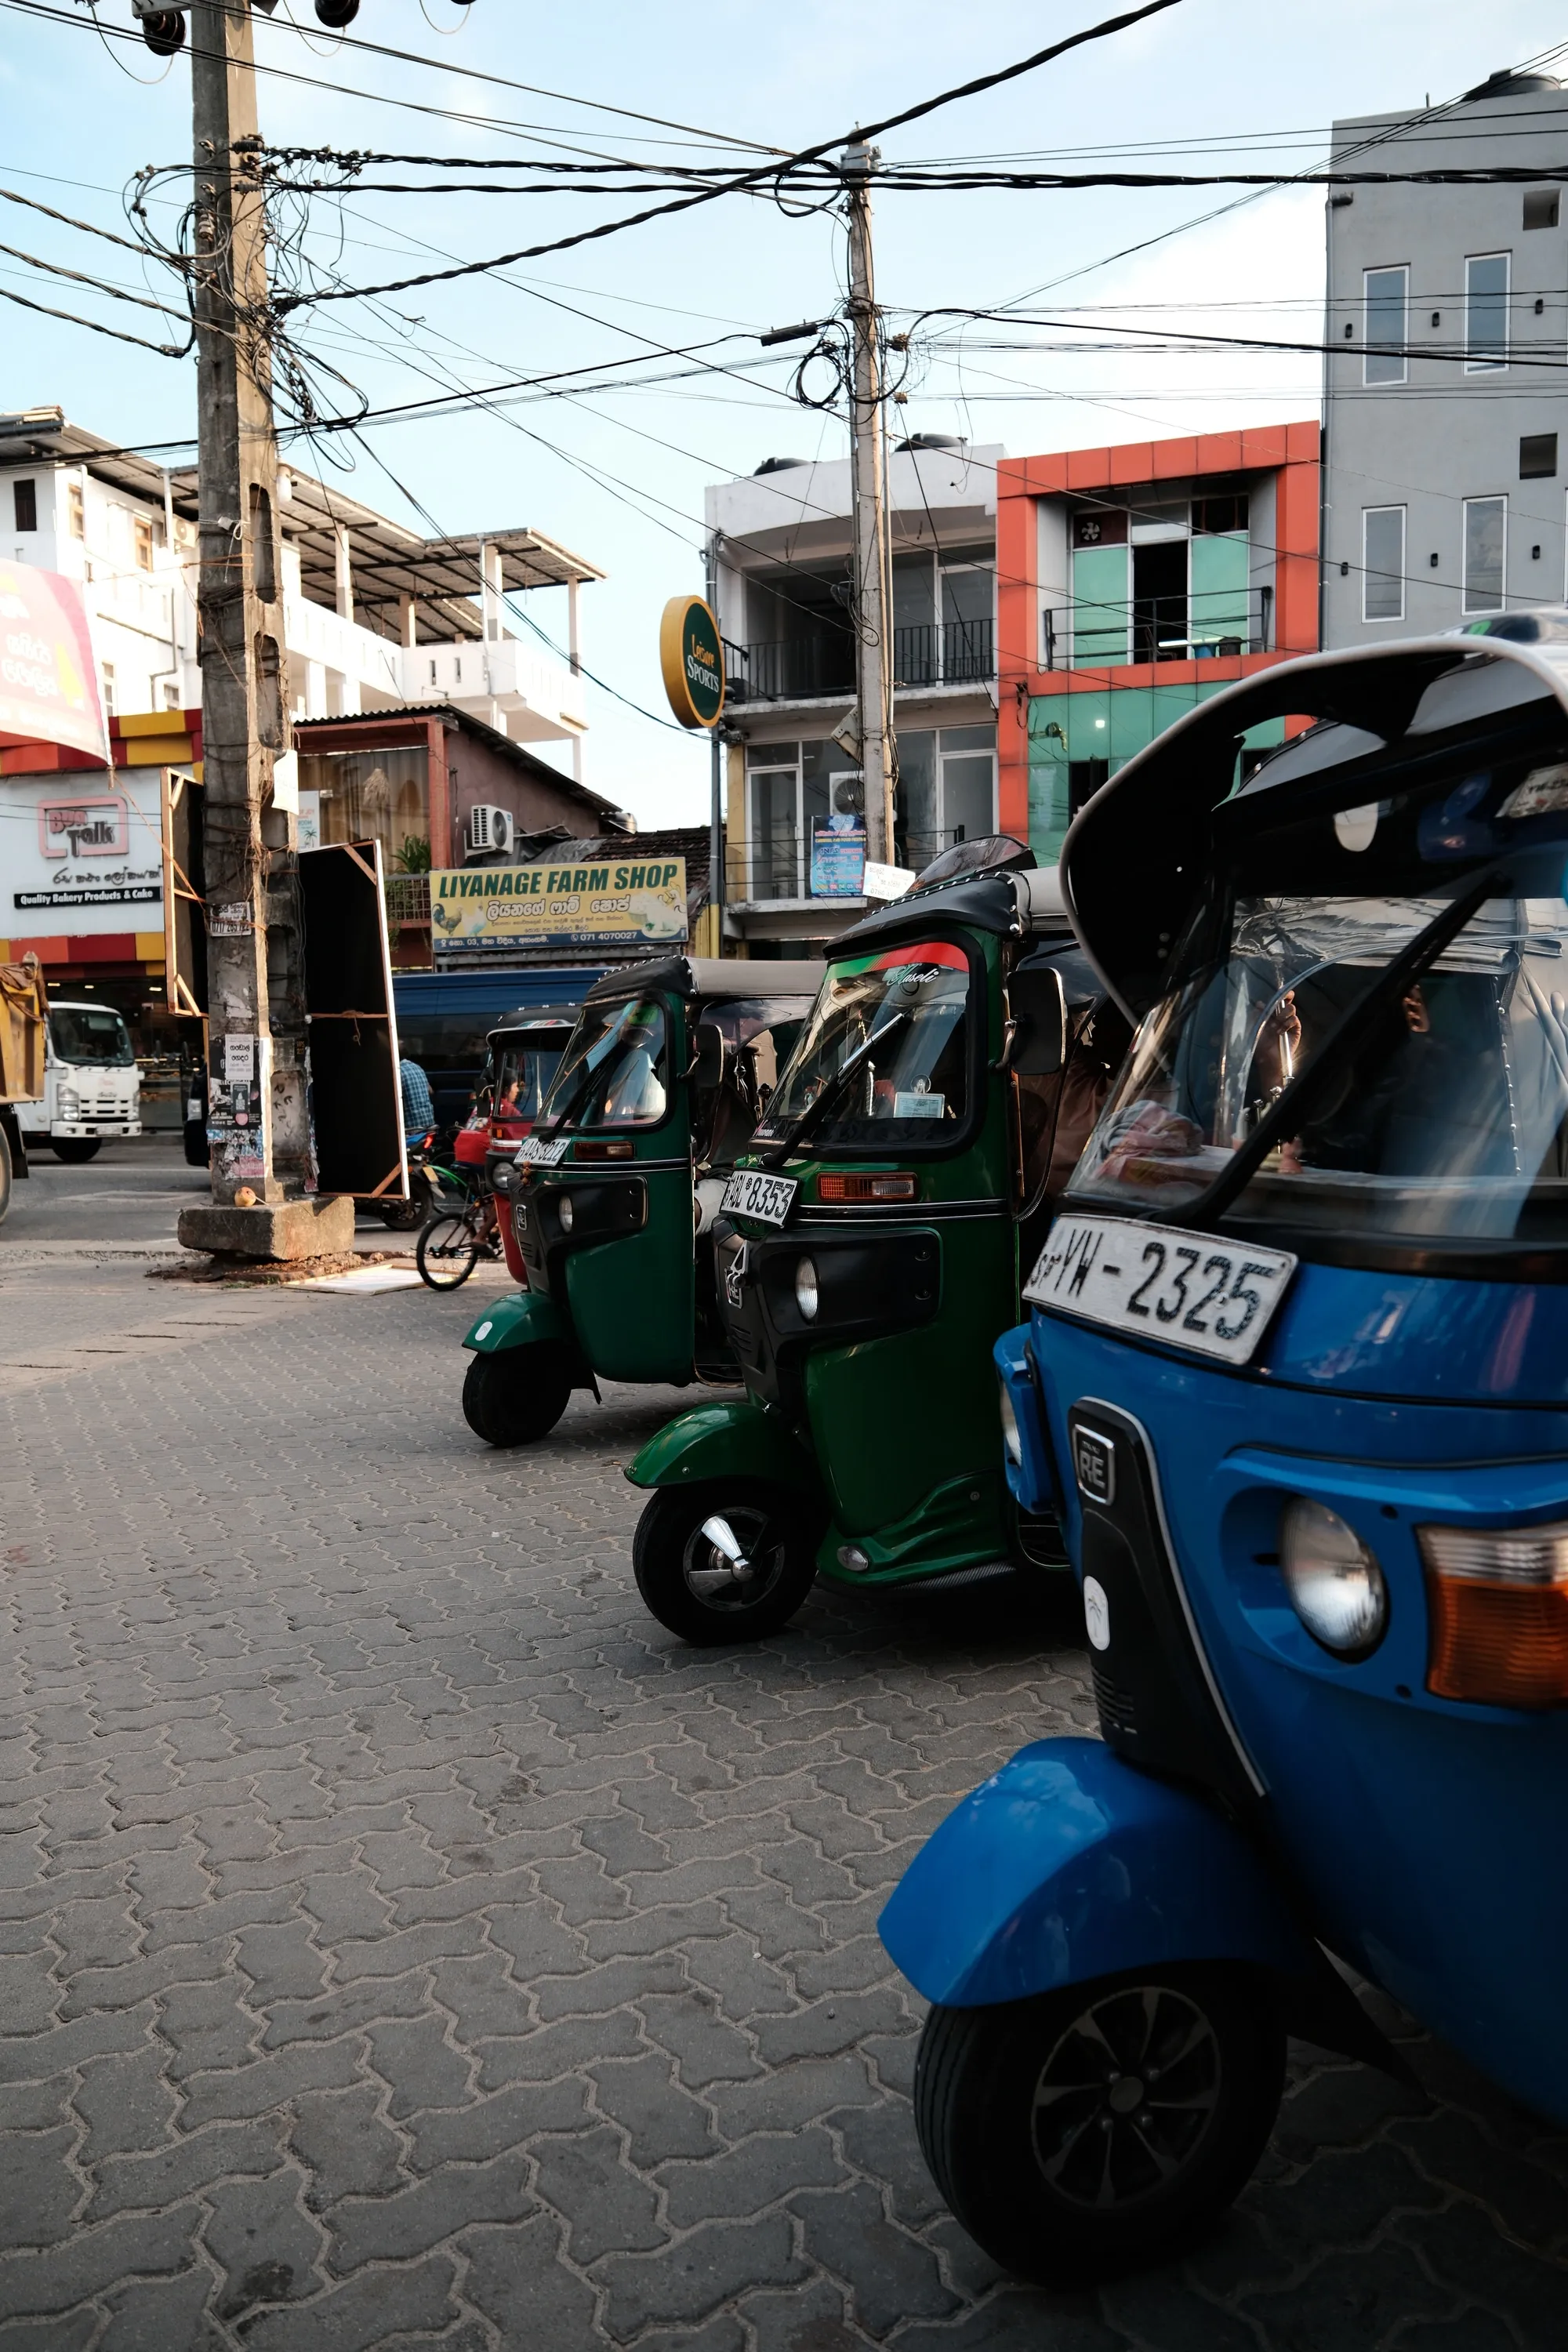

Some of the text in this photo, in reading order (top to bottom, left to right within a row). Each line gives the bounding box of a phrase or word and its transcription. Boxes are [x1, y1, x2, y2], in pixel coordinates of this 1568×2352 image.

[691, 634, 714, 668] Leisure
[49, 811, 88, 833] Bun
[67, 821, 115, 858] Talk
[20, 888, 153, 905] Quality Bakery Products & Cake
[439, 864, 678, 898] LIYANAGE FARM SHOP
[486, 898, 546, 921] ලියනගේ
[590, 894, 631, 913] ෂොප්
[598, 931, 637, 940] 4070027
[746, 1176, 796, 1219] 8353
[1054, 1229, 1105, 1298] YW
[1126, 1241, 1278, 1341] 2325
[1080, 1449, 1106, 1490] RE
